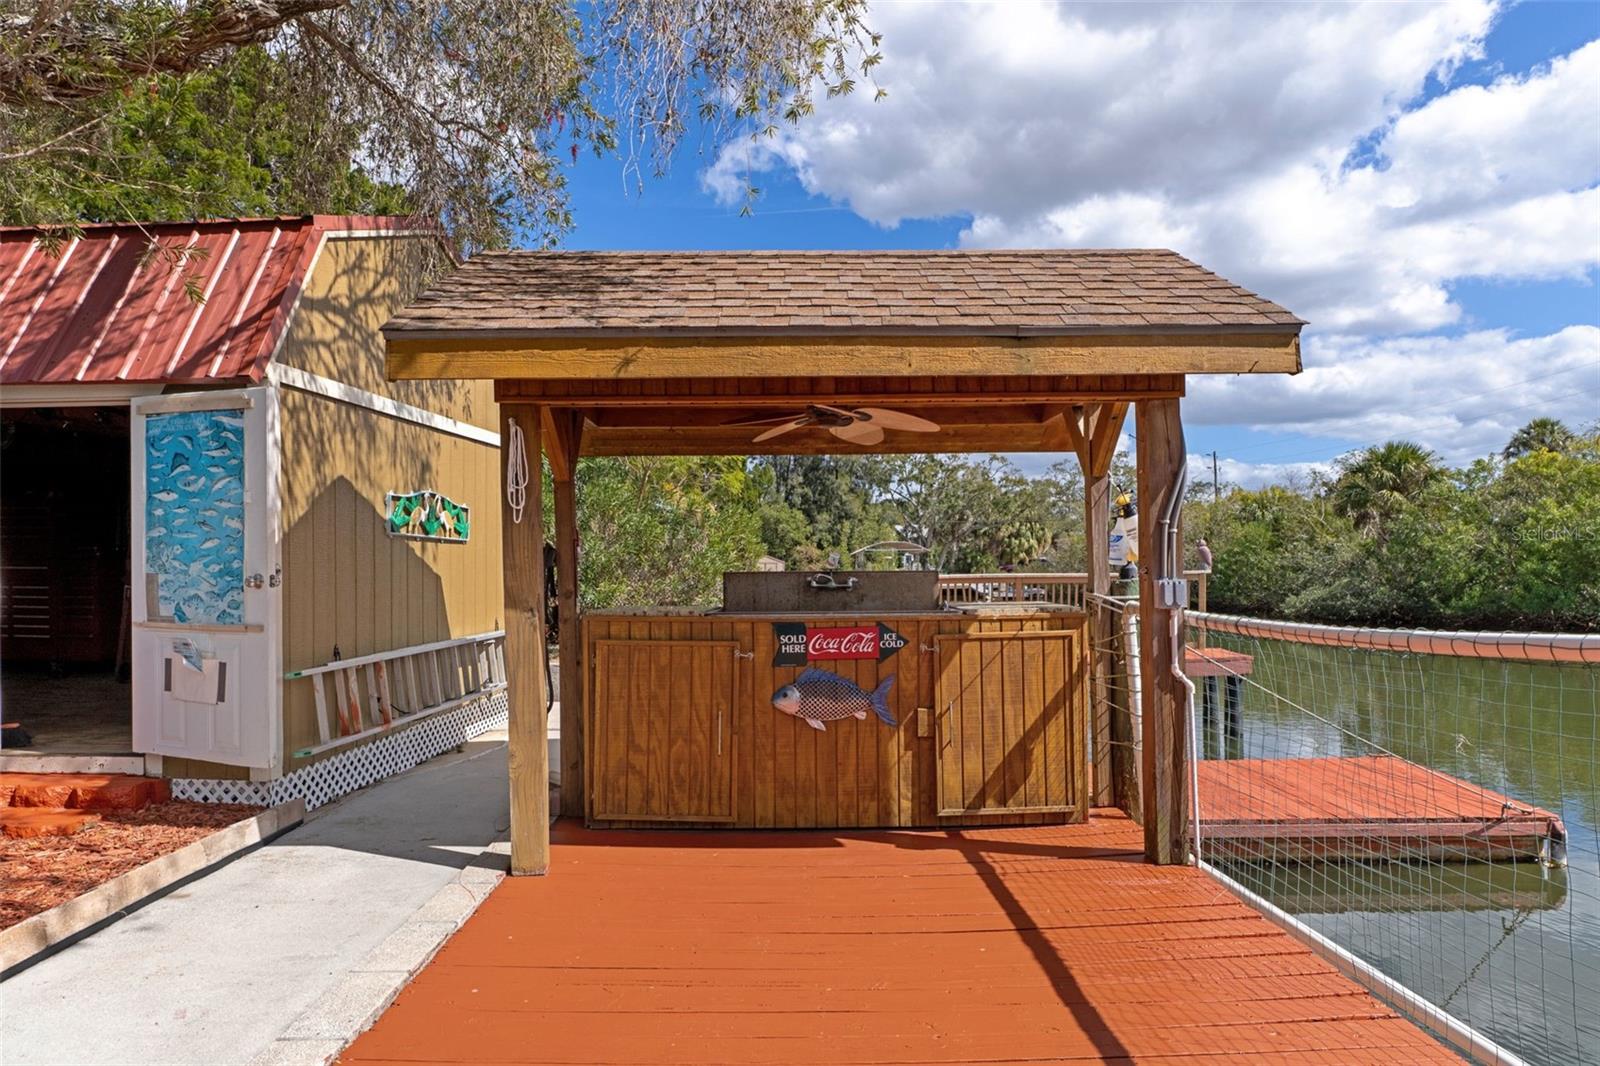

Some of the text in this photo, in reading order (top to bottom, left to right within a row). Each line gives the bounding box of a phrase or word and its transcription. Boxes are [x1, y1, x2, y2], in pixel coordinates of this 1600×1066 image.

[780, 634, 807, 644] SOLD
[808, 632, 877, 655] Coca-Cola
[781, 644, 806, 653] HERE
[880, 640, 904, 648] COLD
